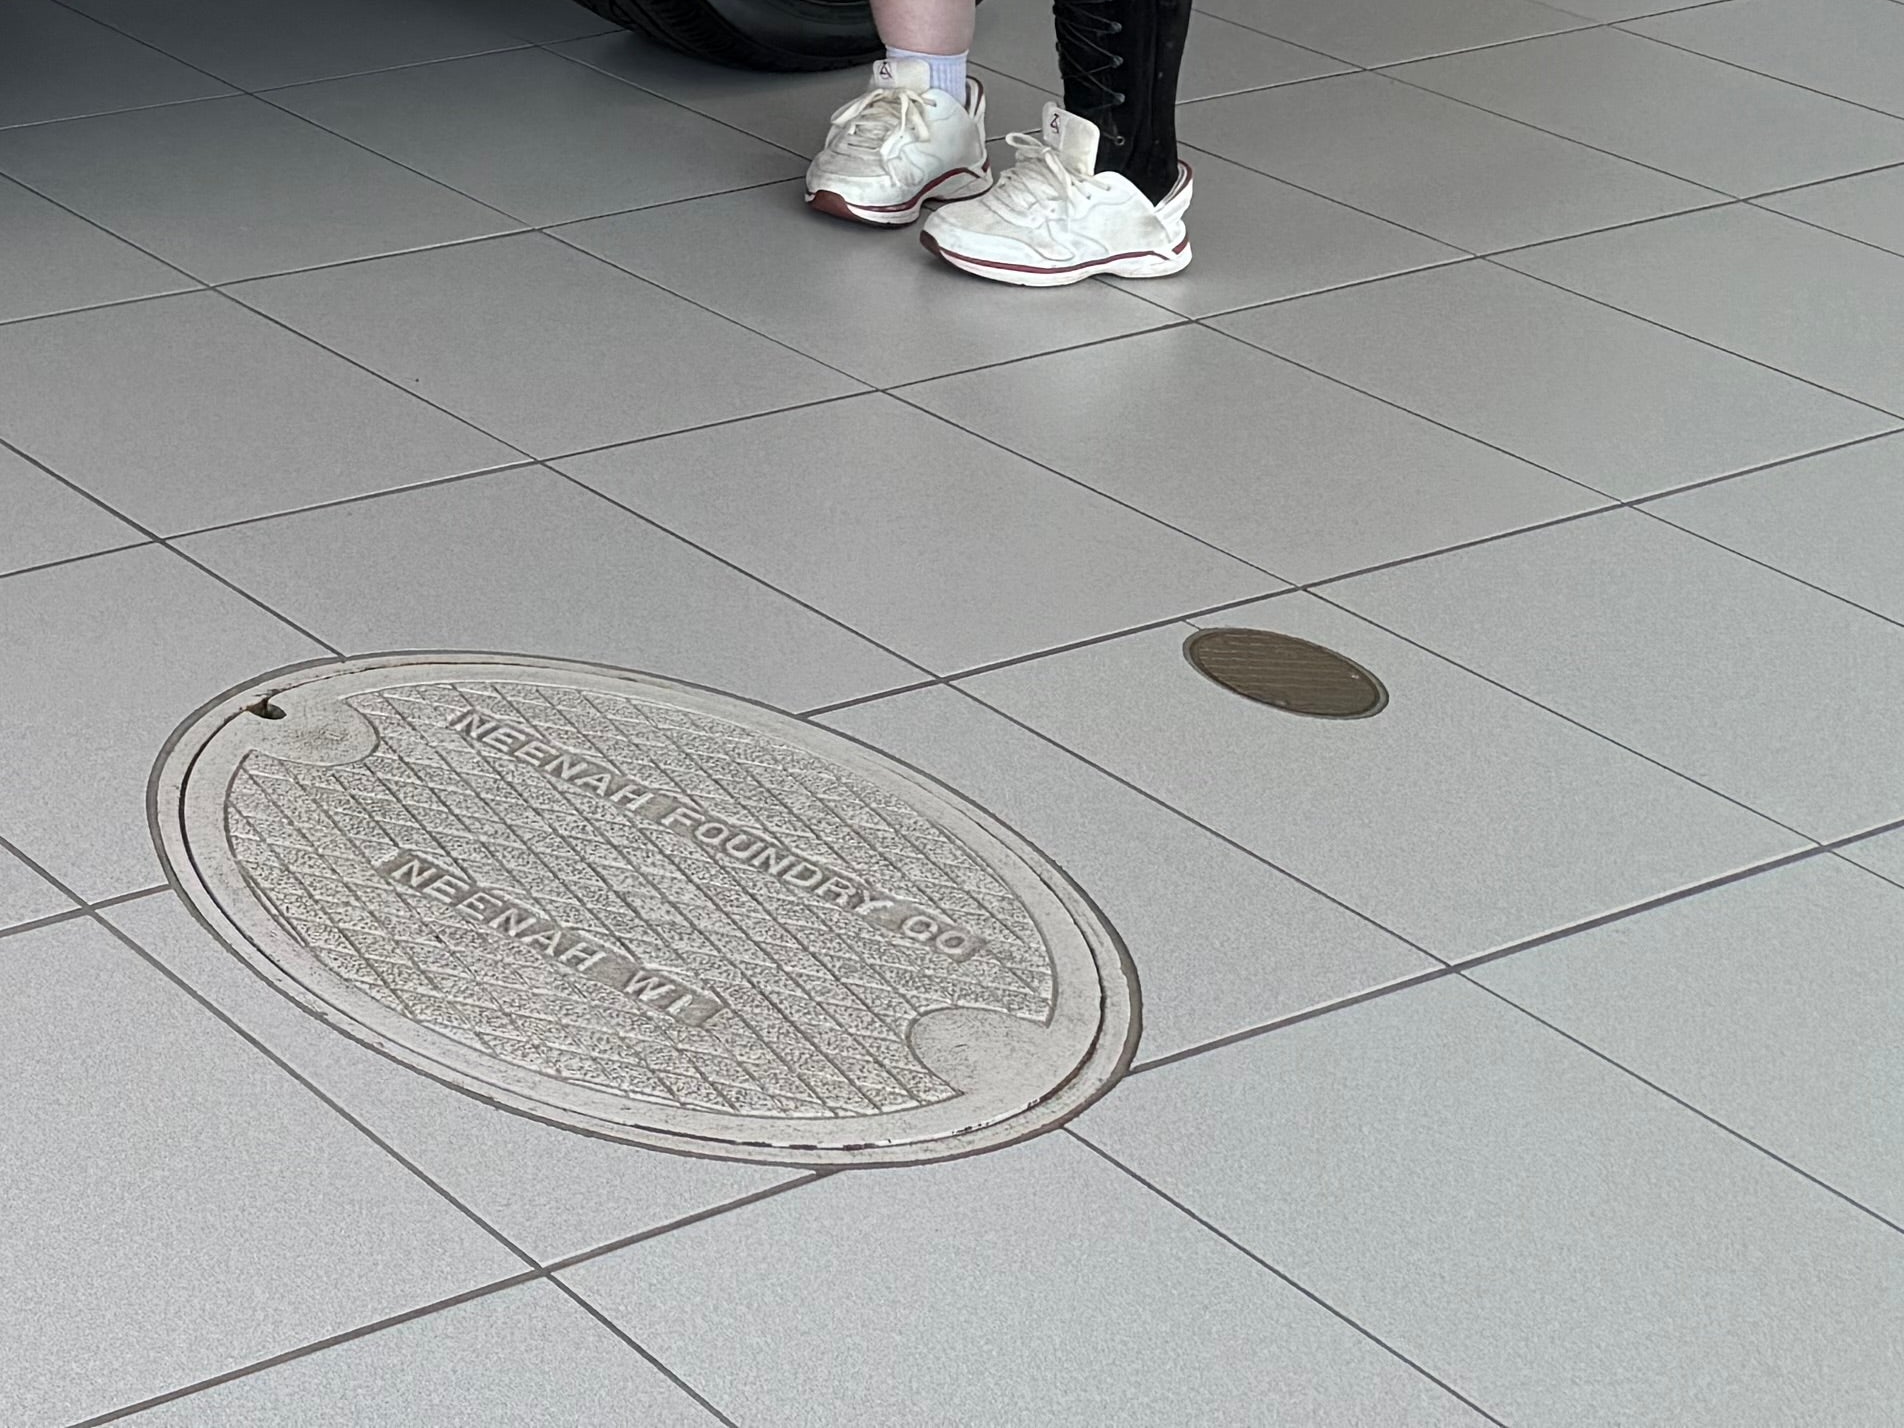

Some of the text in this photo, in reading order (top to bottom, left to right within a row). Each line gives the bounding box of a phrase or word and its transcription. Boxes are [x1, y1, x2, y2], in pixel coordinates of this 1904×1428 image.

[456, 709, 654, 811] NEENAH
[661, 806, 894, 915] FOUNDRY
[391, 858, 608, 973] NEENAH
